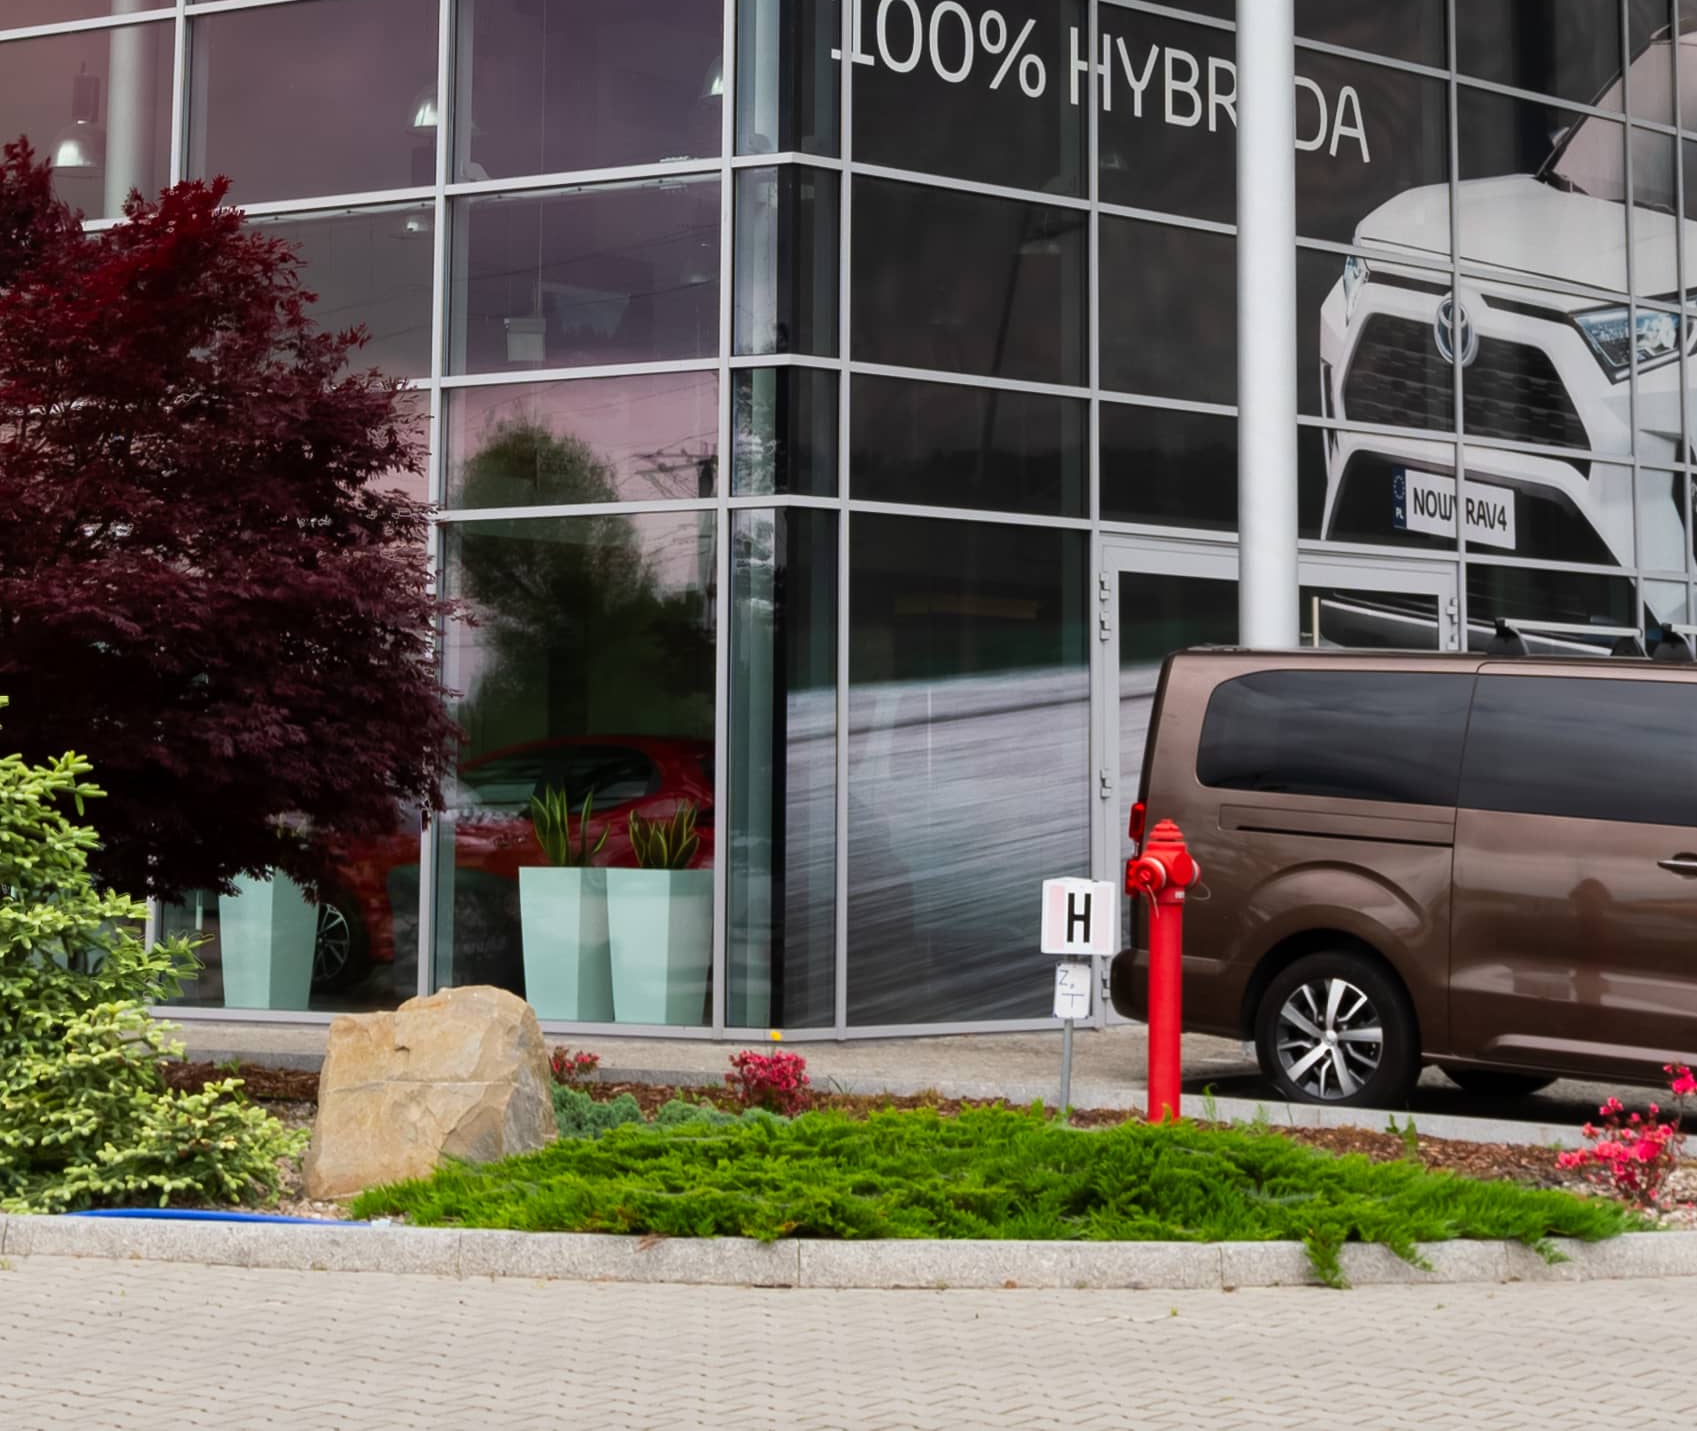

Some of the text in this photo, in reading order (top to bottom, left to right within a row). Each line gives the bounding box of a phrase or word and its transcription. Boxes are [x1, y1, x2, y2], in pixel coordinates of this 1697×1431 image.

[1070, 26, 1371, 164] HYBRDA
[1466, 496, 1507, 531] RAV4
[1067, 892, 1092, 944] H
